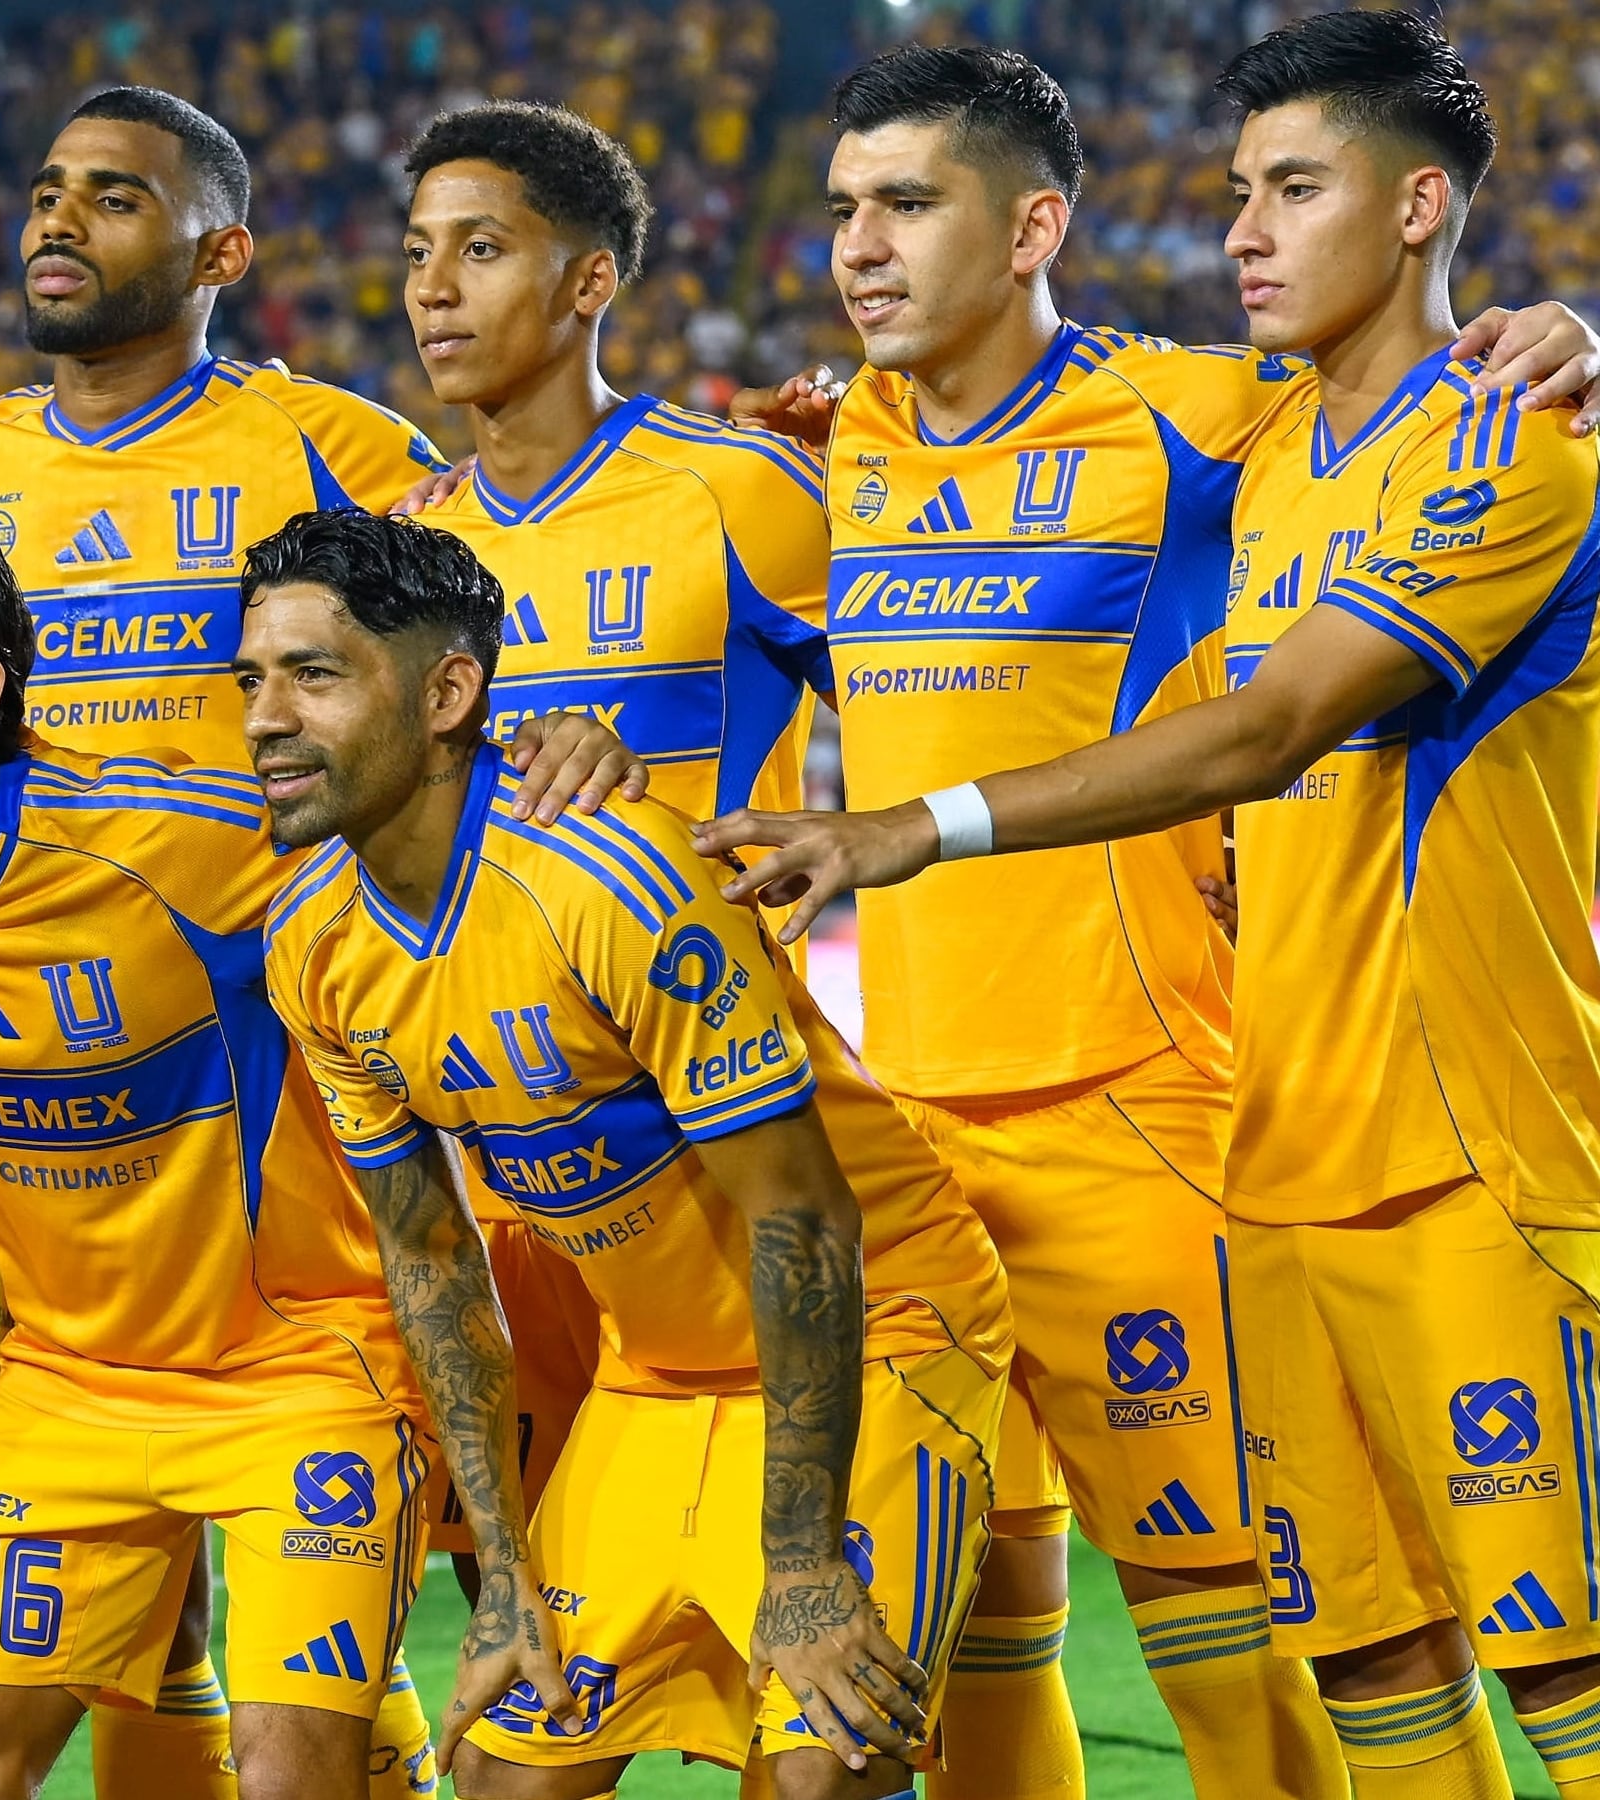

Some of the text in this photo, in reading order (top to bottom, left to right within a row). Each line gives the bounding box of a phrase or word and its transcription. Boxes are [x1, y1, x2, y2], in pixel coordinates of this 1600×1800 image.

[1410, 525, 1485, 552] Berel
[879, 575, 1041, 616] CEMEX
[37, 612, 213, 661] CEMEX
[844, 661, 1031, 709] SPORTIUMBET
[23, 695, 209, 729] PORTIUMBET
[701, 958, 751, 1031] Berel
[357, 1027, 391, 1043] CEMEX
[685, 1014, 790, 1097] telcel
[489, 1135, 623, 1195] EMEX
[1148, 1398, 1209, 1421] GAS
[1245, 1430, 1277, 1462] EMEX
[1497, 1470, 1558, 1497] GAS
[333, 1537, 385, 1562] GAS
[537, 1581, 587, 1617] MEX
